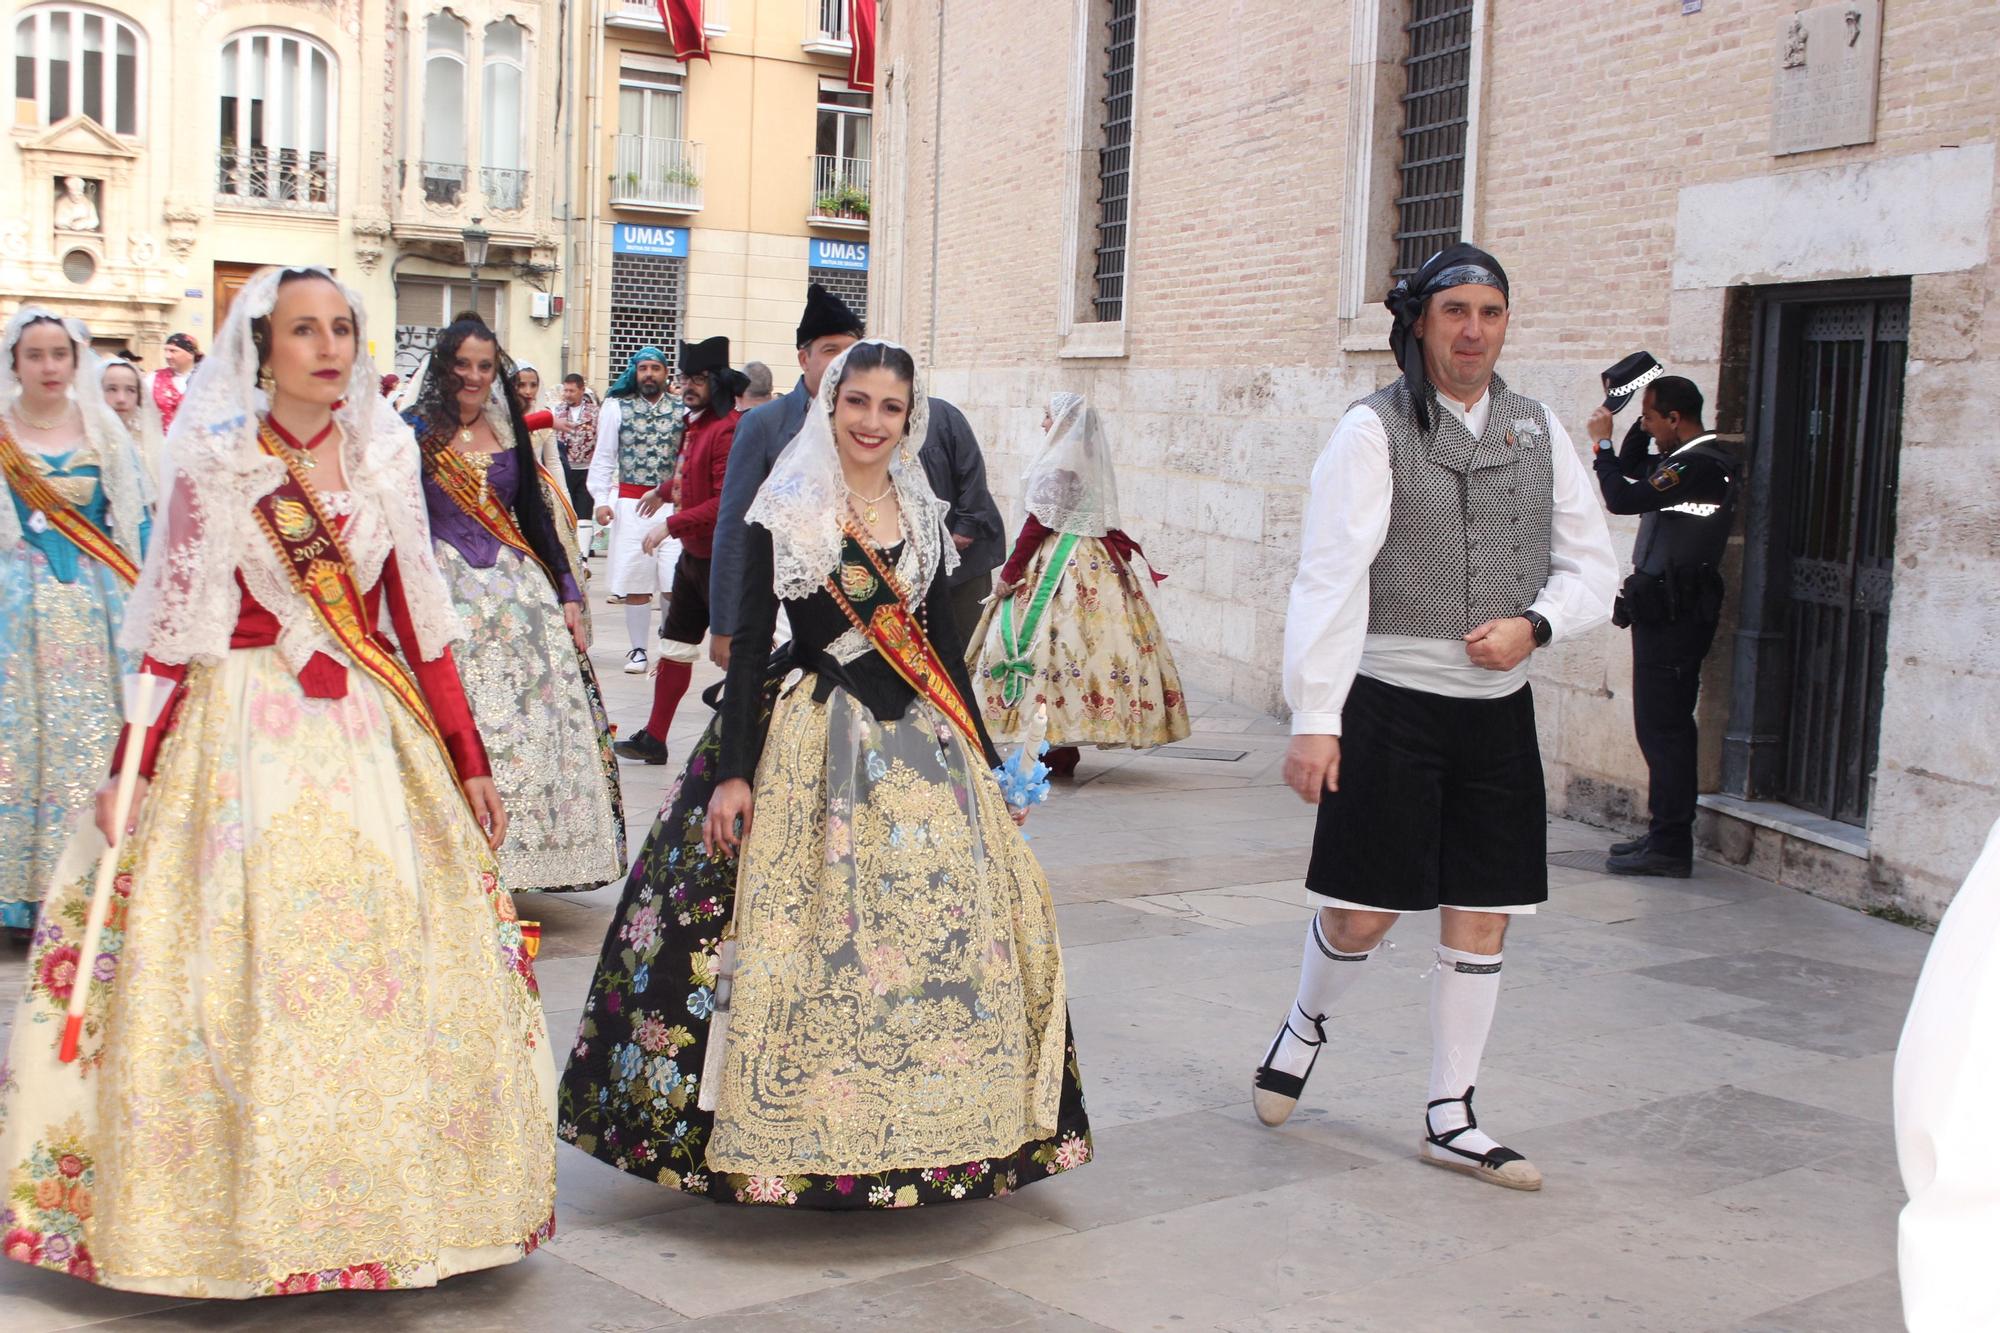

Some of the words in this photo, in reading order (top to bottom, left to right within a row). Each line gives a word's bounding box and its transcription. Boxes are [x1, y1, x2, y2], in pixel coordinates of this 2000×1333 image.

[624, 226, 675, 246] UMAS
[820, 242, 866, 261] UMAS
[293, 536, 331, 562] 2021
